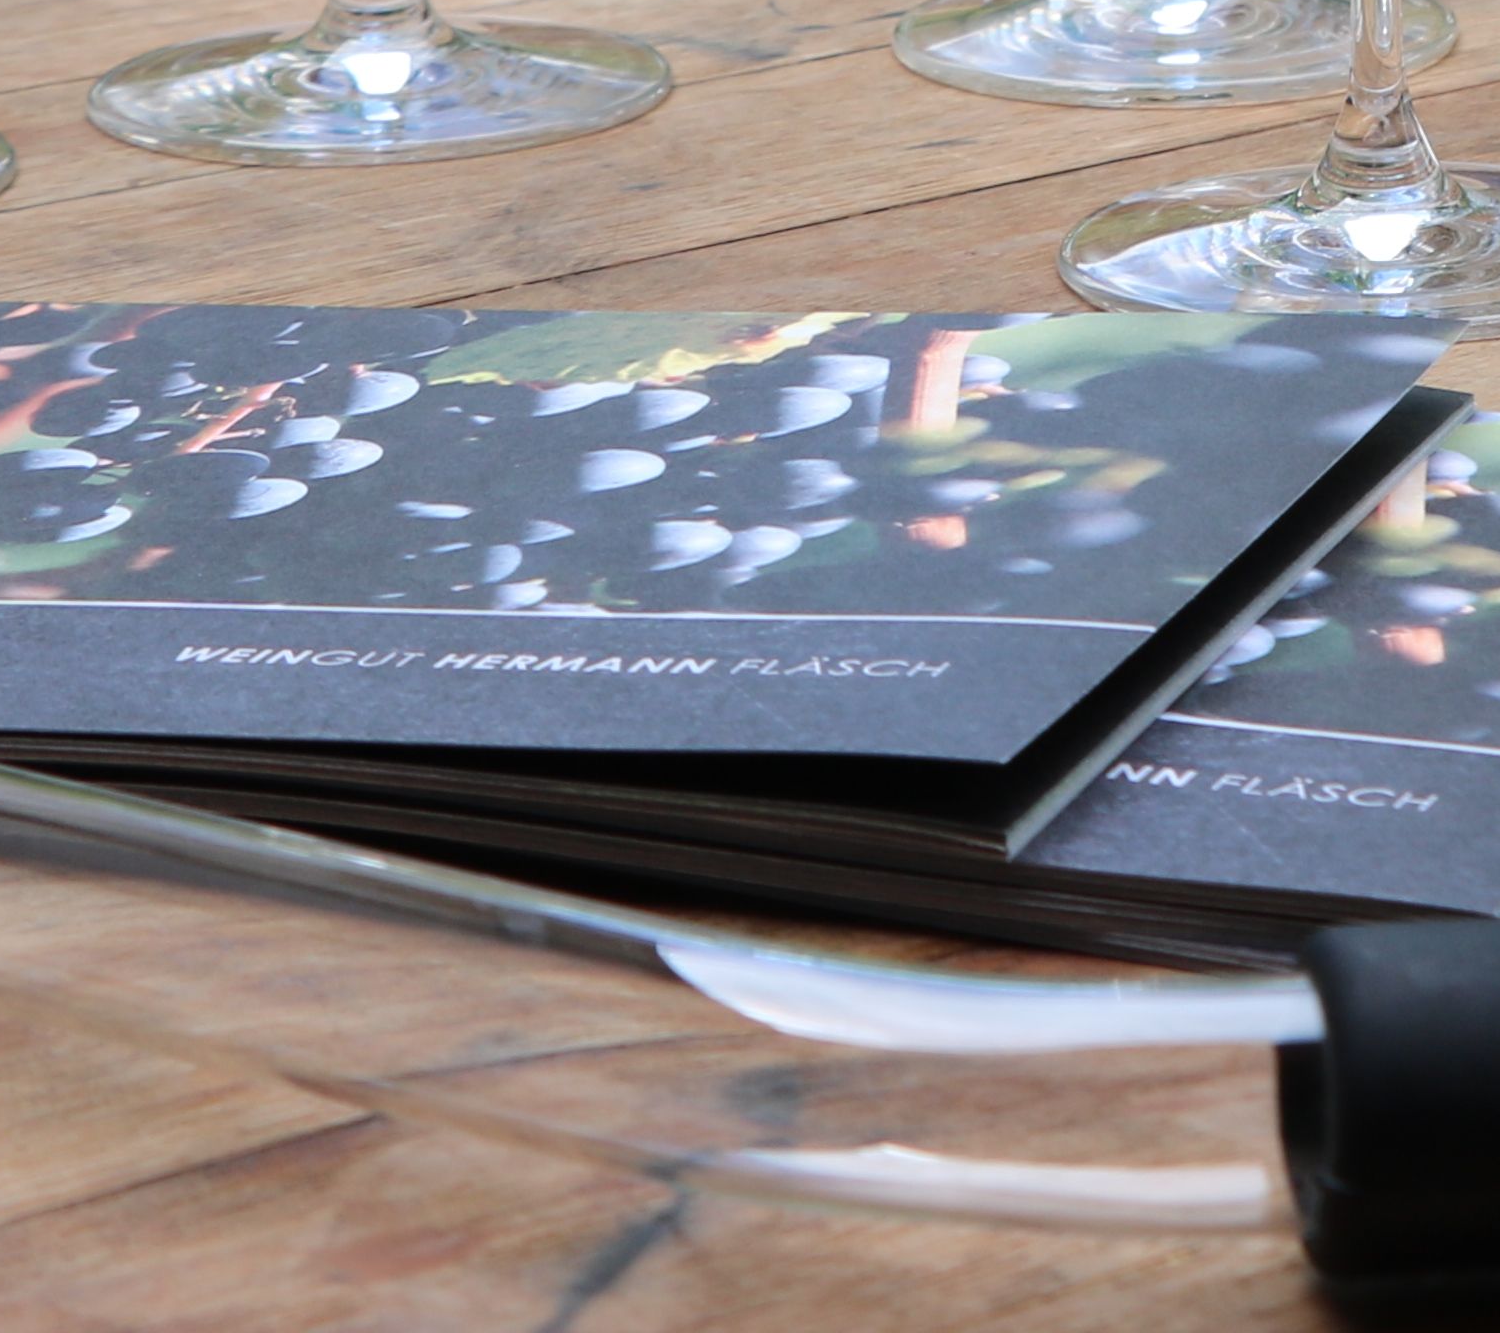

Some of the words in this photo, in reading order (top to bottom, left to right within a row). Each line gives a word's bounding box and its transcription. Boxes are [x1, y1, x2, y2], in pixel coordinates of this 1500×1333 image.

[174, 645, 425, 669] WEINGUT
[432, 652, 717, 676] HERMANN
[729, 655, 953, 679] FLÄSCH
[1211, 772, 1439, 813] FLÄSCH
